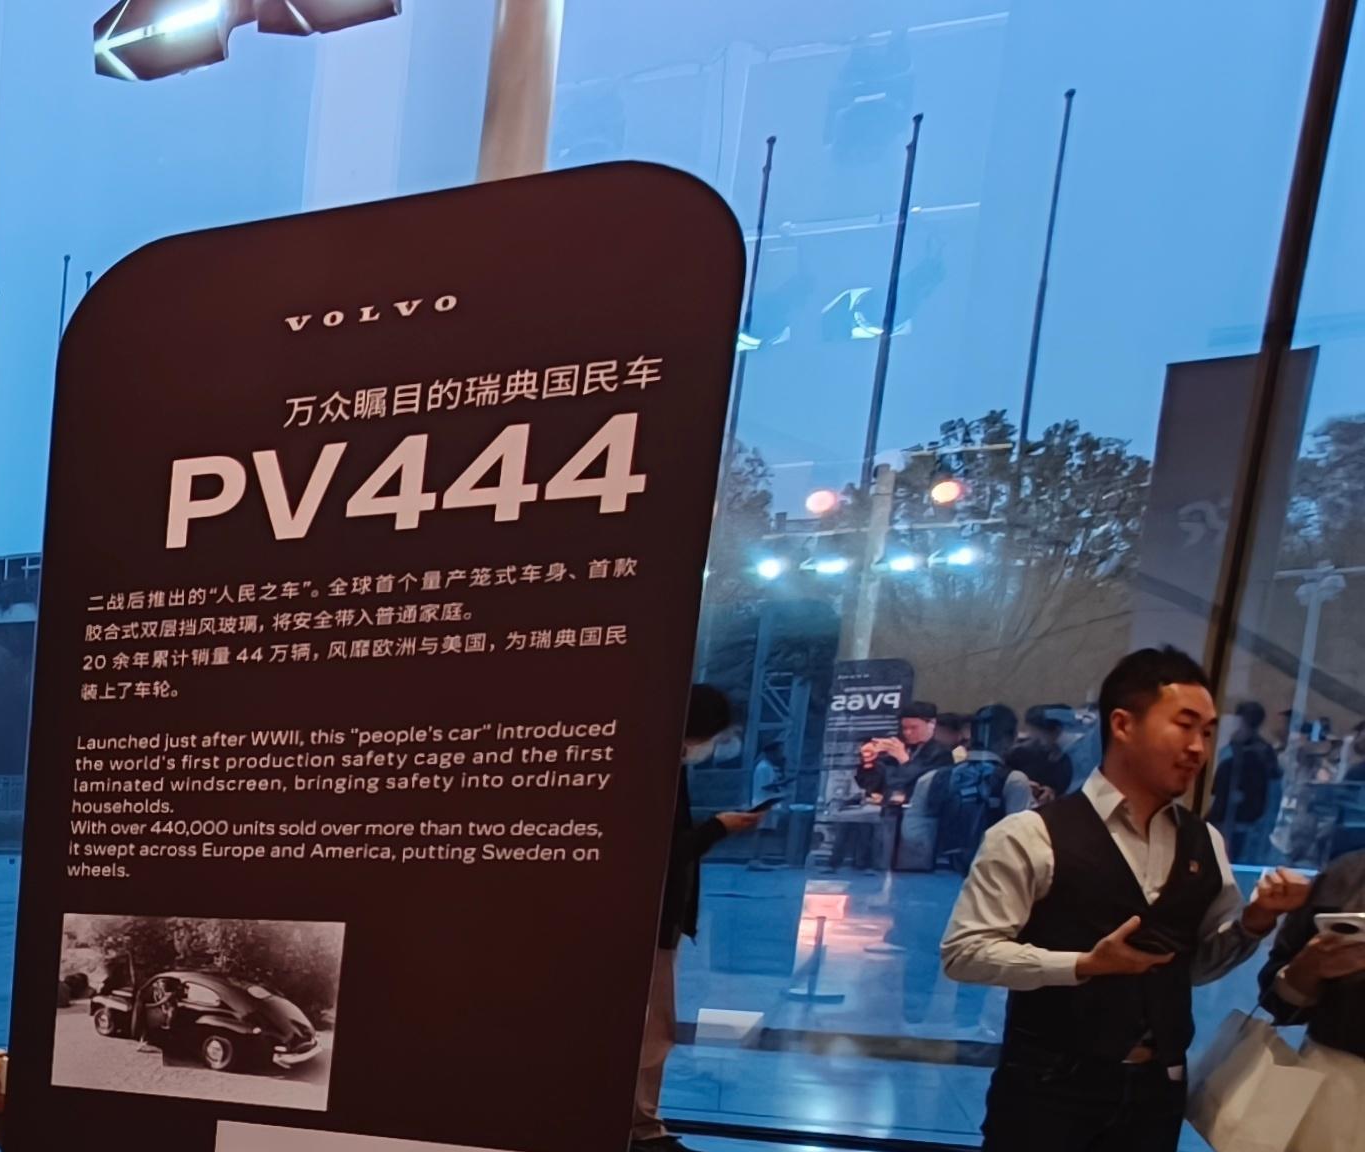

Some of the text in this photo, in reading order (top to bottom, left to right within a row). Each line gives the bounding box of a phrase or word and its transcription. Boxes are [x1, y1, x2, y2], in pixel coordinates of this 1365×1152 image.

[284, 294, 458, 332] VOLVO
[282, 354, 664, 429] 万众瞩目的瑞典国民车
[165, 411, 648, 550] PV444
[82, 654, 107, 671] 20
[235, 646, 264, 664] 44
[76, 719, 617, 753] Launched just after WWII, this "people's car" introduced
[75, 744, 614, 773] the world's first production safety cage and the first
[73, 769, 611, 795] laminated windscreen, bringing safety into ordinary
[71, 798, 174, 815] households.
[70, 818, 604, 839] With over 440,000 units sold over more than two decades,
[68, 840, 600, 865] it swept across Europe and America, putting Sweden on
[66, 861, 131, 878] wheels.
